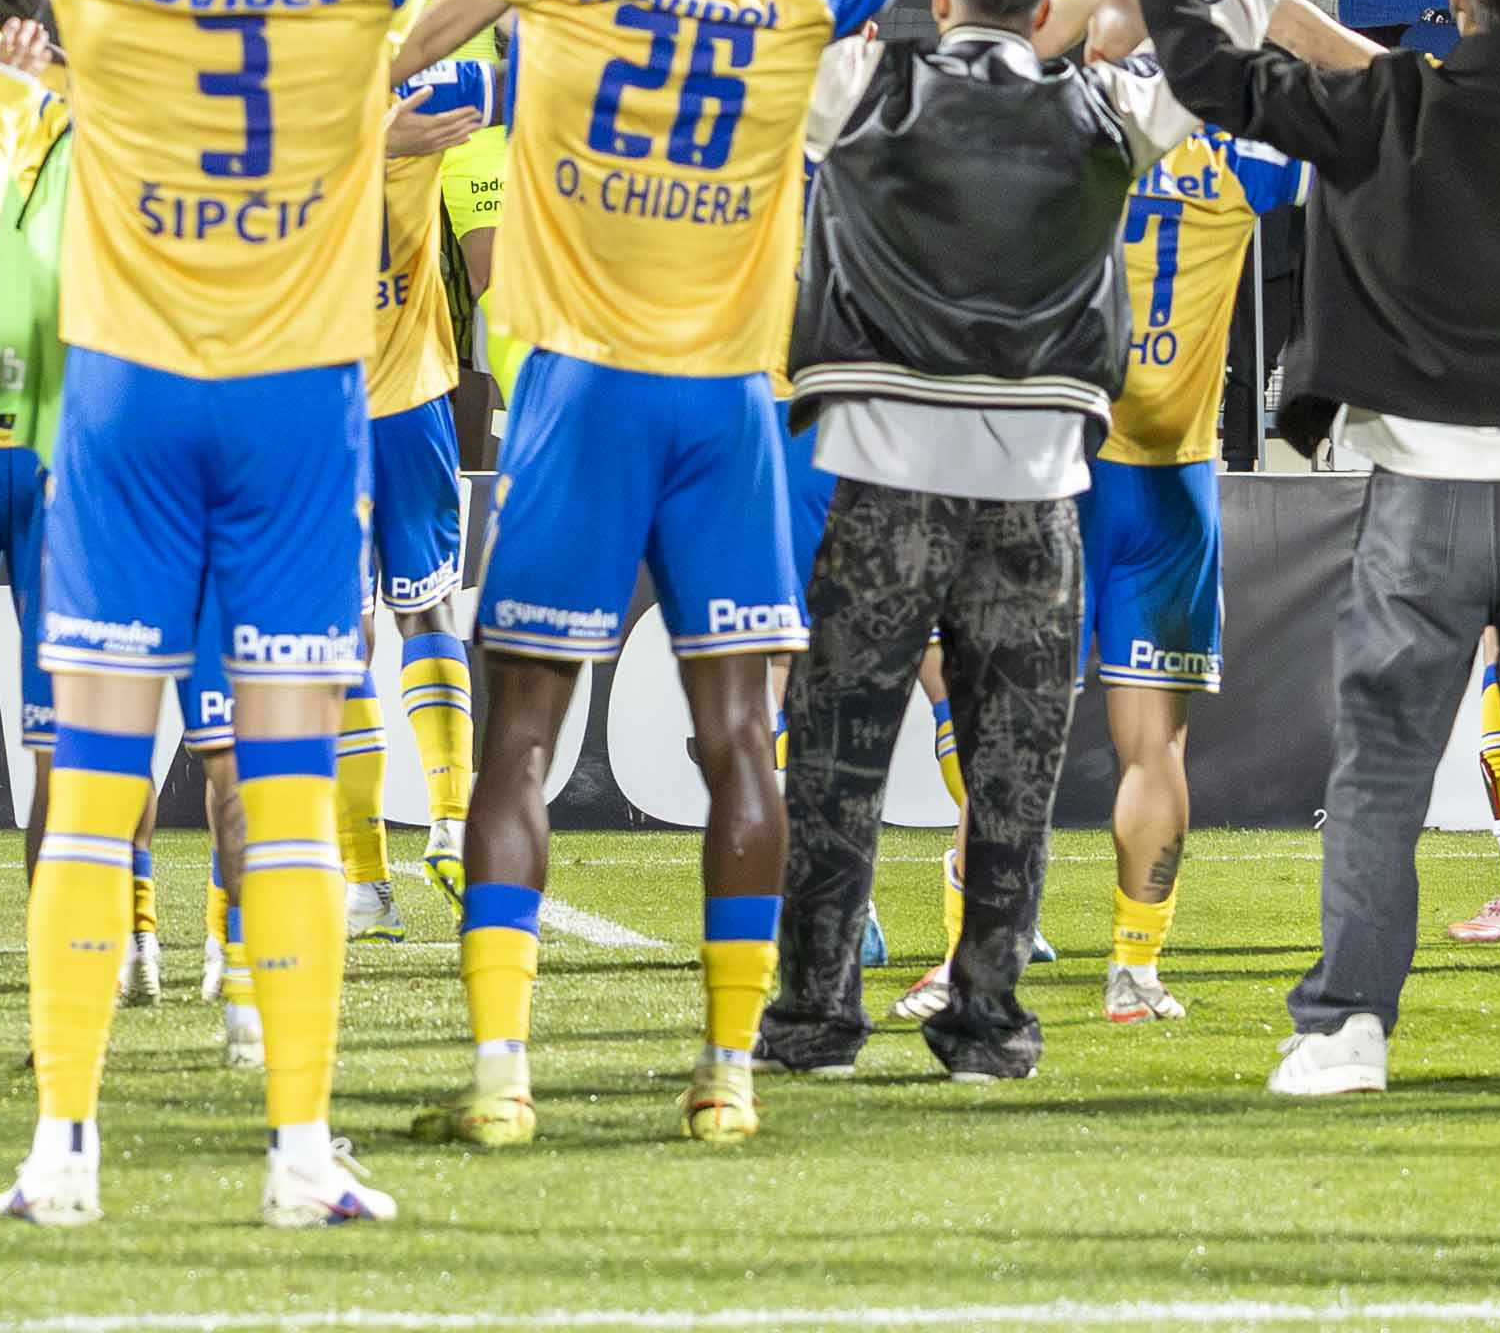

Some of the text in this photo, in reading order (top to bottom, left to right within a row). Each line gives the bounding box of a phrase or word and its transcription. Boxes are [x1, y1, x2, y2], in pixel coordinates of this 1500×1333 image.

[194, 14, 273, 180] 3
[587, 2, 755, 171] 26
[600, 172, 753, 226] CHIDERA
